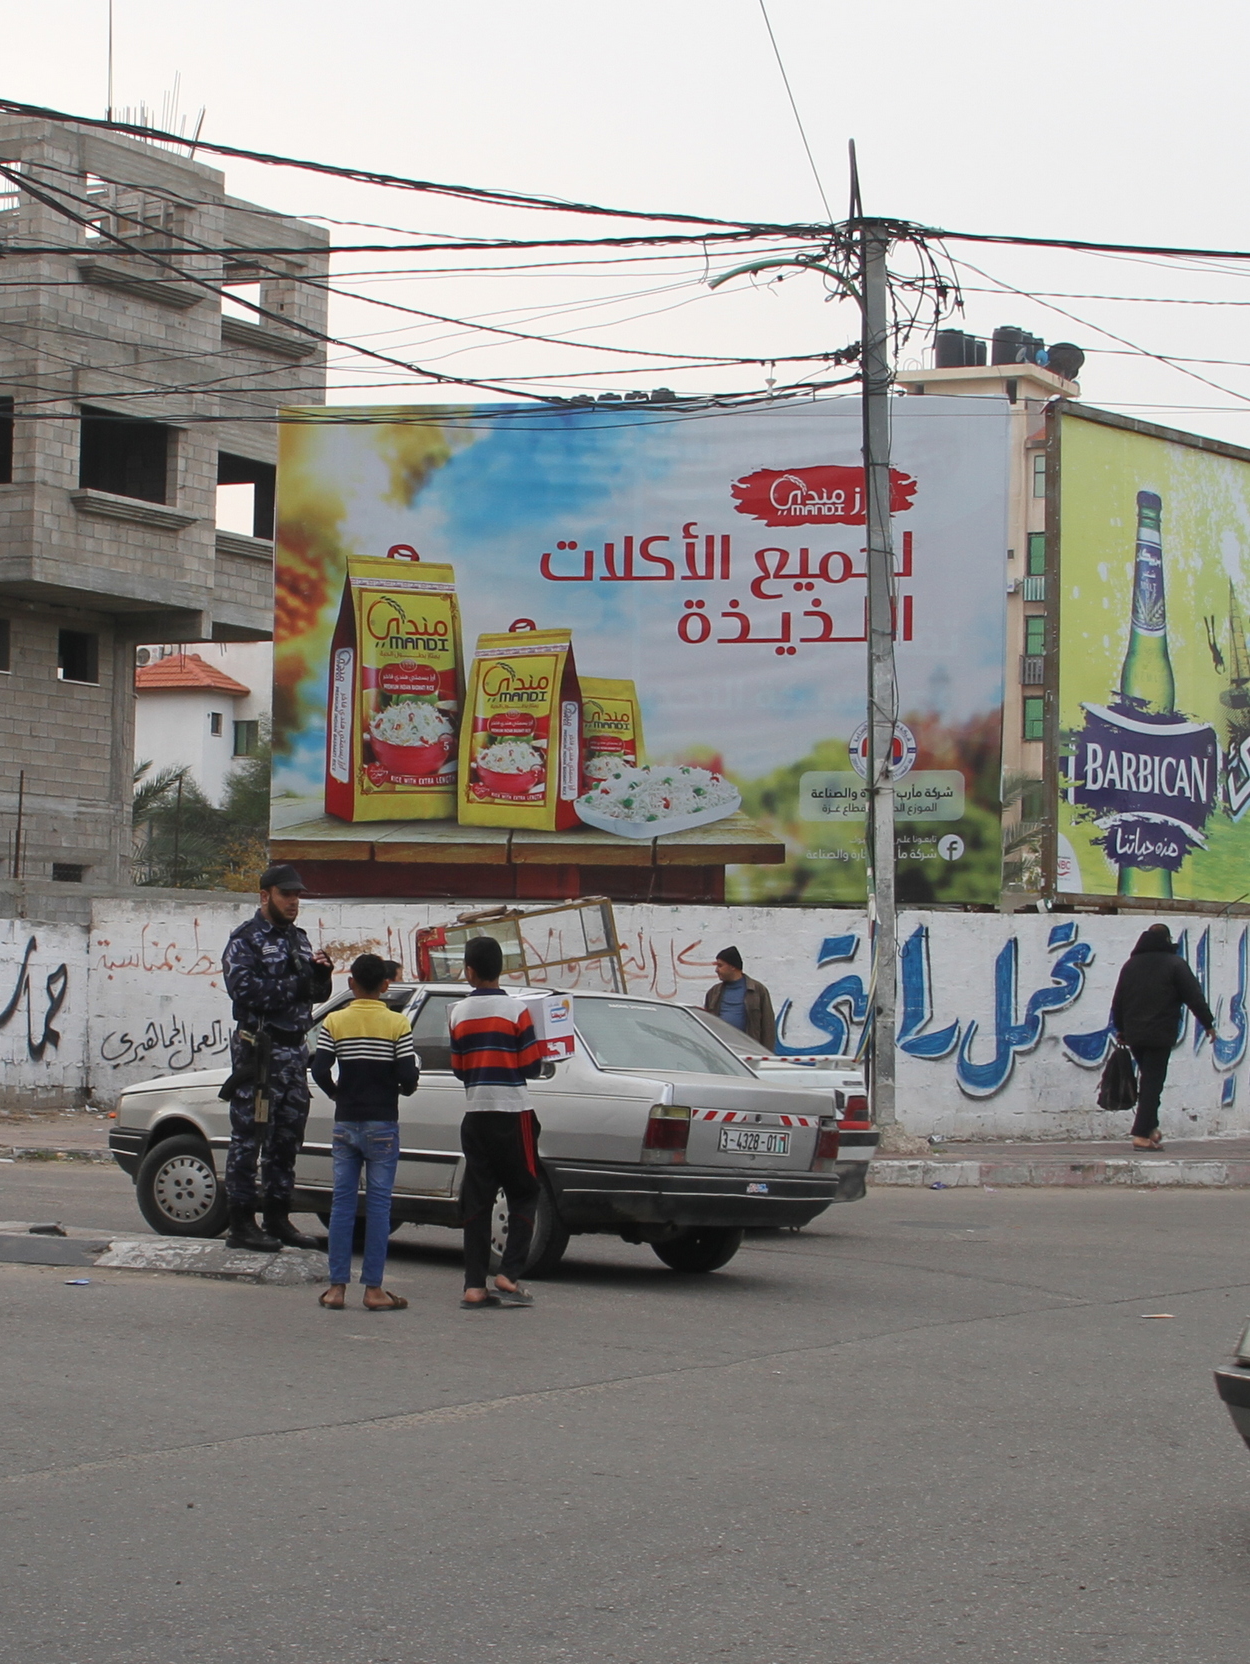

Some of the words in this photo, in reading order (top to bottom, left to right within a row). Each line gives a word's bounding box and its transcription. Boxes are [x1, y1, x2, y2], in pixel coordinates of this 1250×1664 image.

[791, 504, 844, 515] MANDI
[540, 522, 730, 581] الأكلات
[750, 531, 912, 599] لميع
[390, 636, 449, 651] MANDI
[499, 691, 547, 702] MANDI
[594, 721, 630, 731] MANDI
[1084, 743, 1208, 804] BARBICAN
[811, 787, 857, 800] والصناعة
[896, 784, 922, 801] مأرب
[924, 786, 953, 800] شركة
[822, 804, 840, 814] غزة
[907, 803, 937, 816] الموزع
[912, 835, 937, 845] تابعونا
[1116, 827, 1154, 861] حياتنا
[806, 848, 848, 861] والصناعة
[910, 848, 937, 861] شركة
[168, 1019, 222, 1070] العمل
